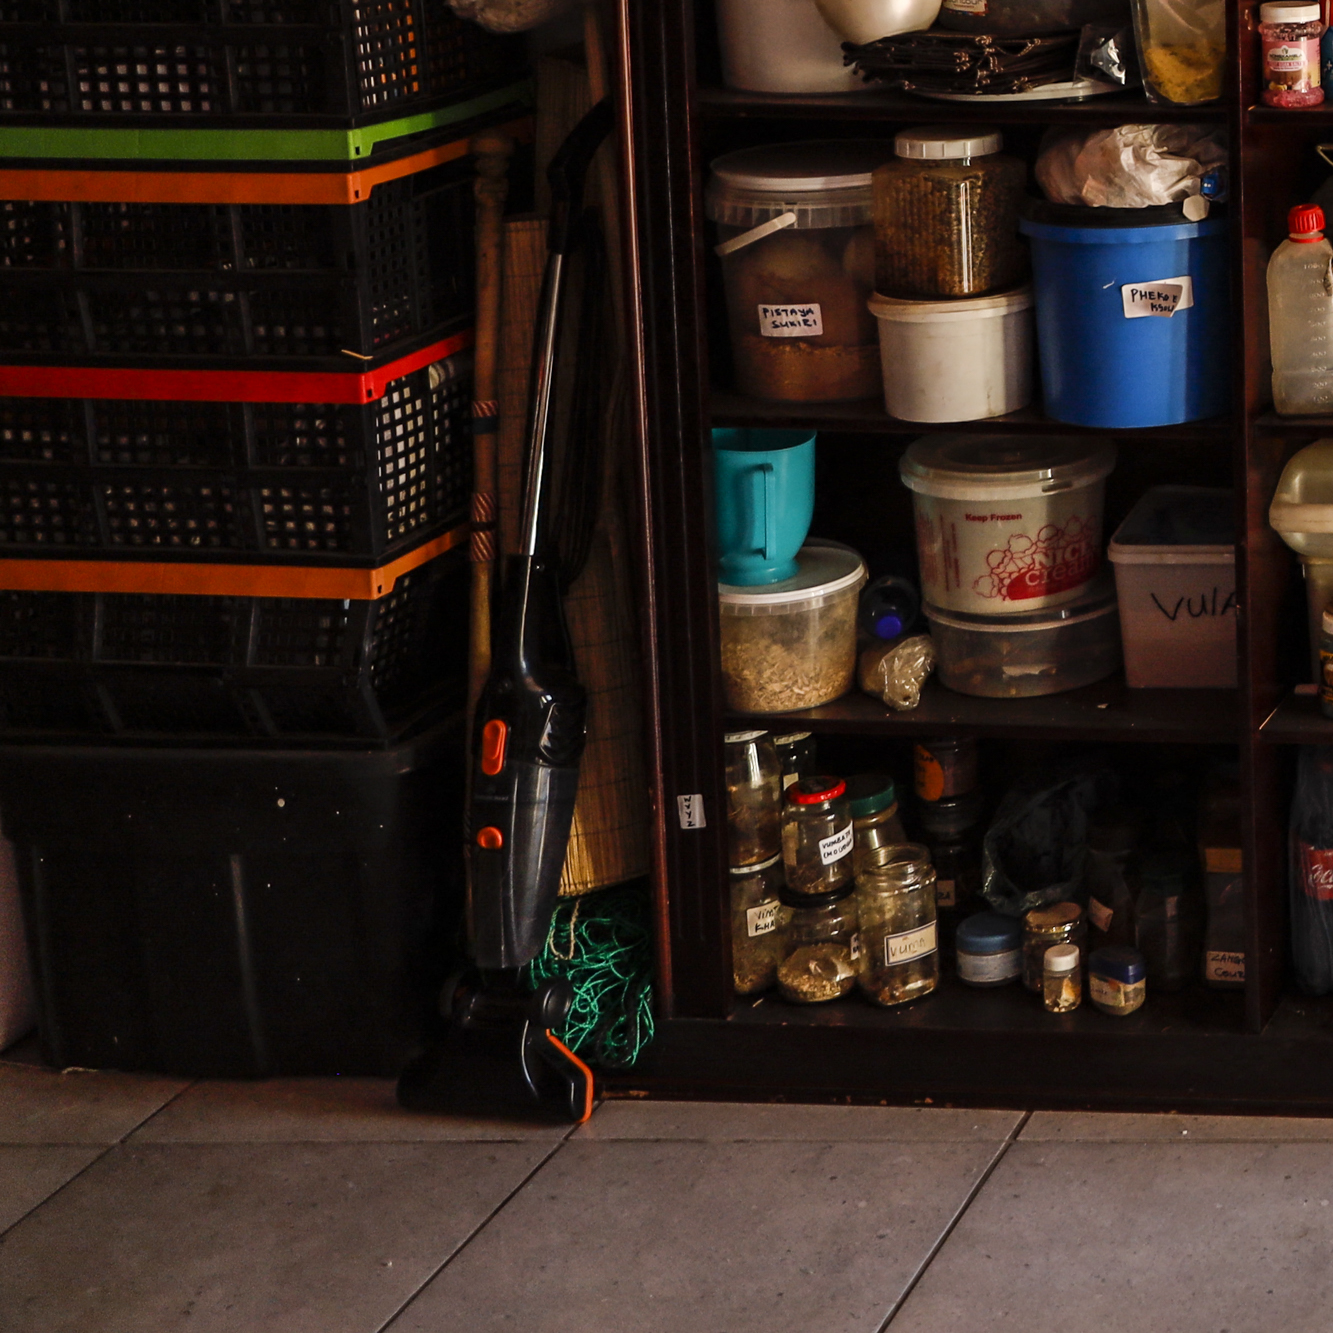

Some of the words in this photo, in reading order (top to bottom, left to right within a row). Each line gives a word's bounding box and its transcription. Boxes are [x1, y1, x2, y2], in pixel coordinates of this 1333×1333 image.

[771, 318, 818, 330] SUKIRI
[965, 512, 995, 523] Keep
[996, 512, 1023, 522] Frozen
